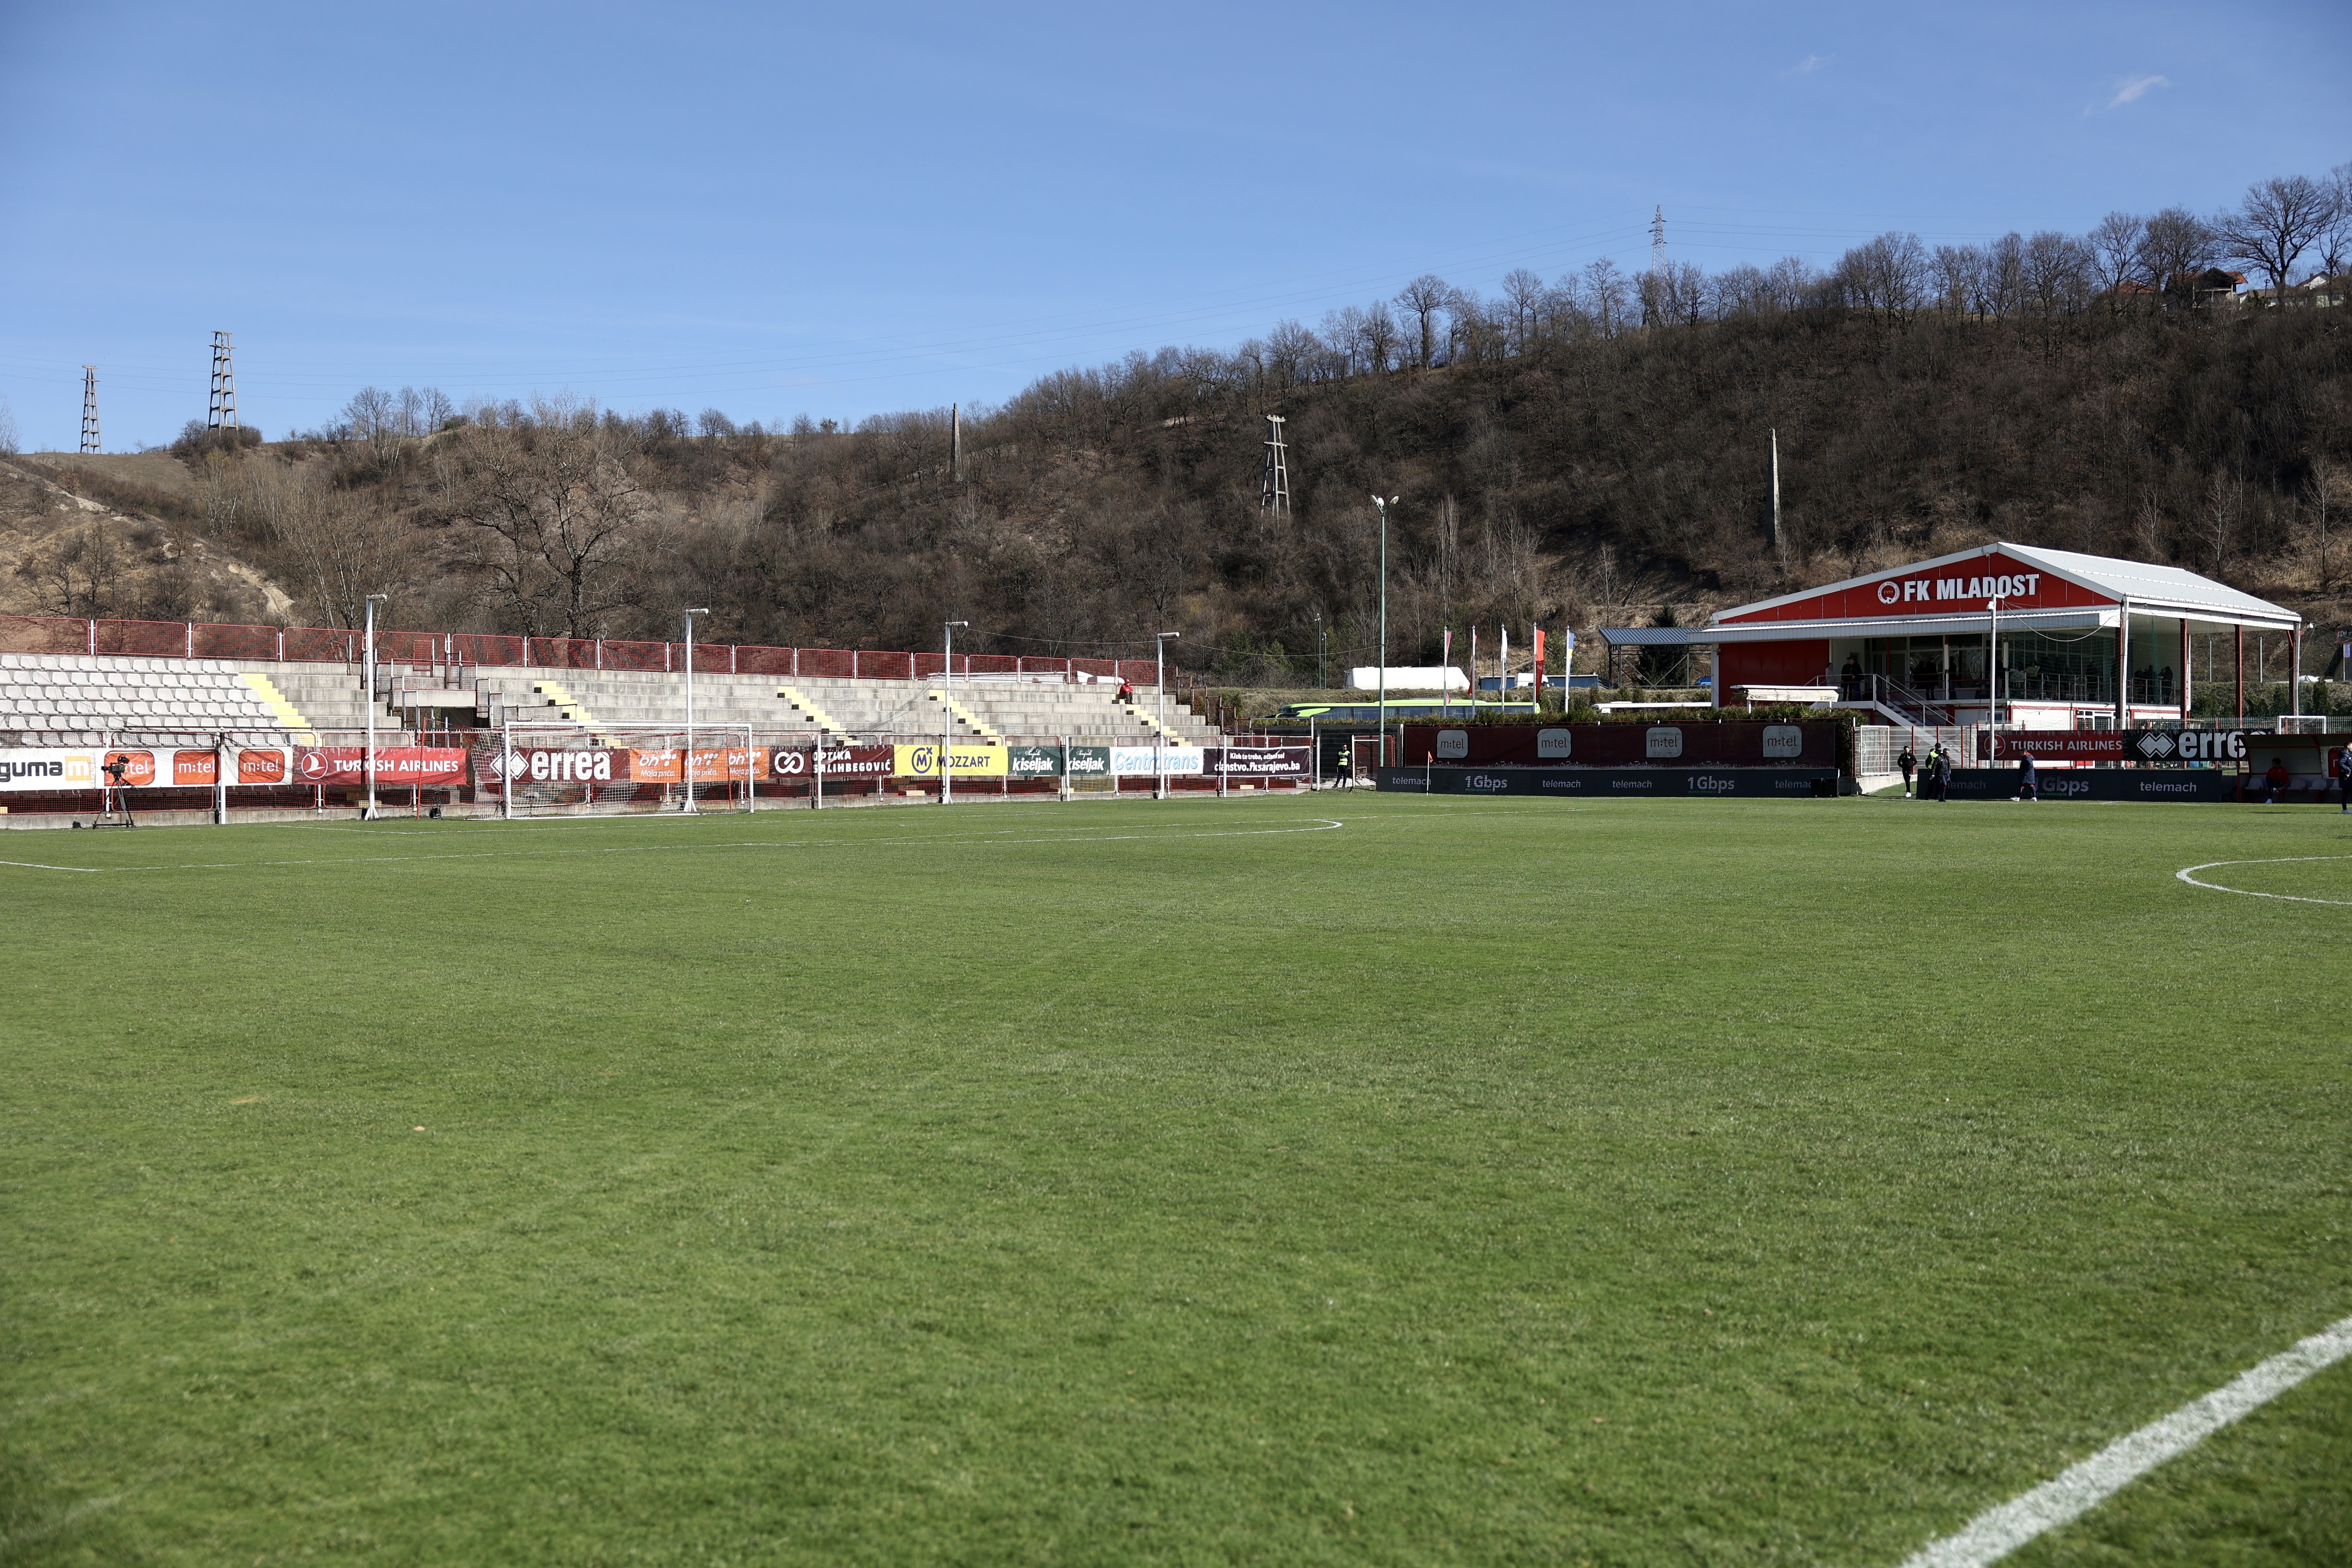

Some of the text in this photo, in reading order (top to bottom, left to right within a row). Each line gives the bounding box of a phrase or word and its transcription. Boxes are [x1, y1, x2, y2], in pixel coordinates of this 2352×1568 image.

[1904, 574, 2040, 602] FK MLADOST
[1440, 738, 1464, 749] m:tel
[1541, 737, 1568, 748] m:tel
[1650, 736, 1678, 748] m:tel
[1767, 735, 1797, 747] m:tel
[2011, 740, 2123, 750] TURKISH AIRLINES
[2178, 731, 2266, 758] erre
[812, 750, 851, 761] OPTIKA
[1114, 751, 1198, 771] Centrotrans
[178, 759, 216, 773] m:tel
[243, 758, 280, 772] m:tel
[398, 760, 459, 772] AIRLINES
[531, 751, 611, 780] errea
[812, 759, 891, 774] SALIHBEGOVIĆ
[936, 756, 990, 768] MOZZART
[1012, 757, 1054, 773] kiseljak
[0, 761, 63, 782] guma
[640, 769, 676, 778] Moja priča.
[686, 769, 718, 778] oja priča.
[729, 767, 761, 776] Moja pča.
[1392, 777, 1431, 785] telemach
[1542, 779, 1581, 788] telemach
[1612, 780, 1652, 788] telemach
[1775, 780, 1811, 788] telemac
[2140, 781, 2197, 792] telemach
